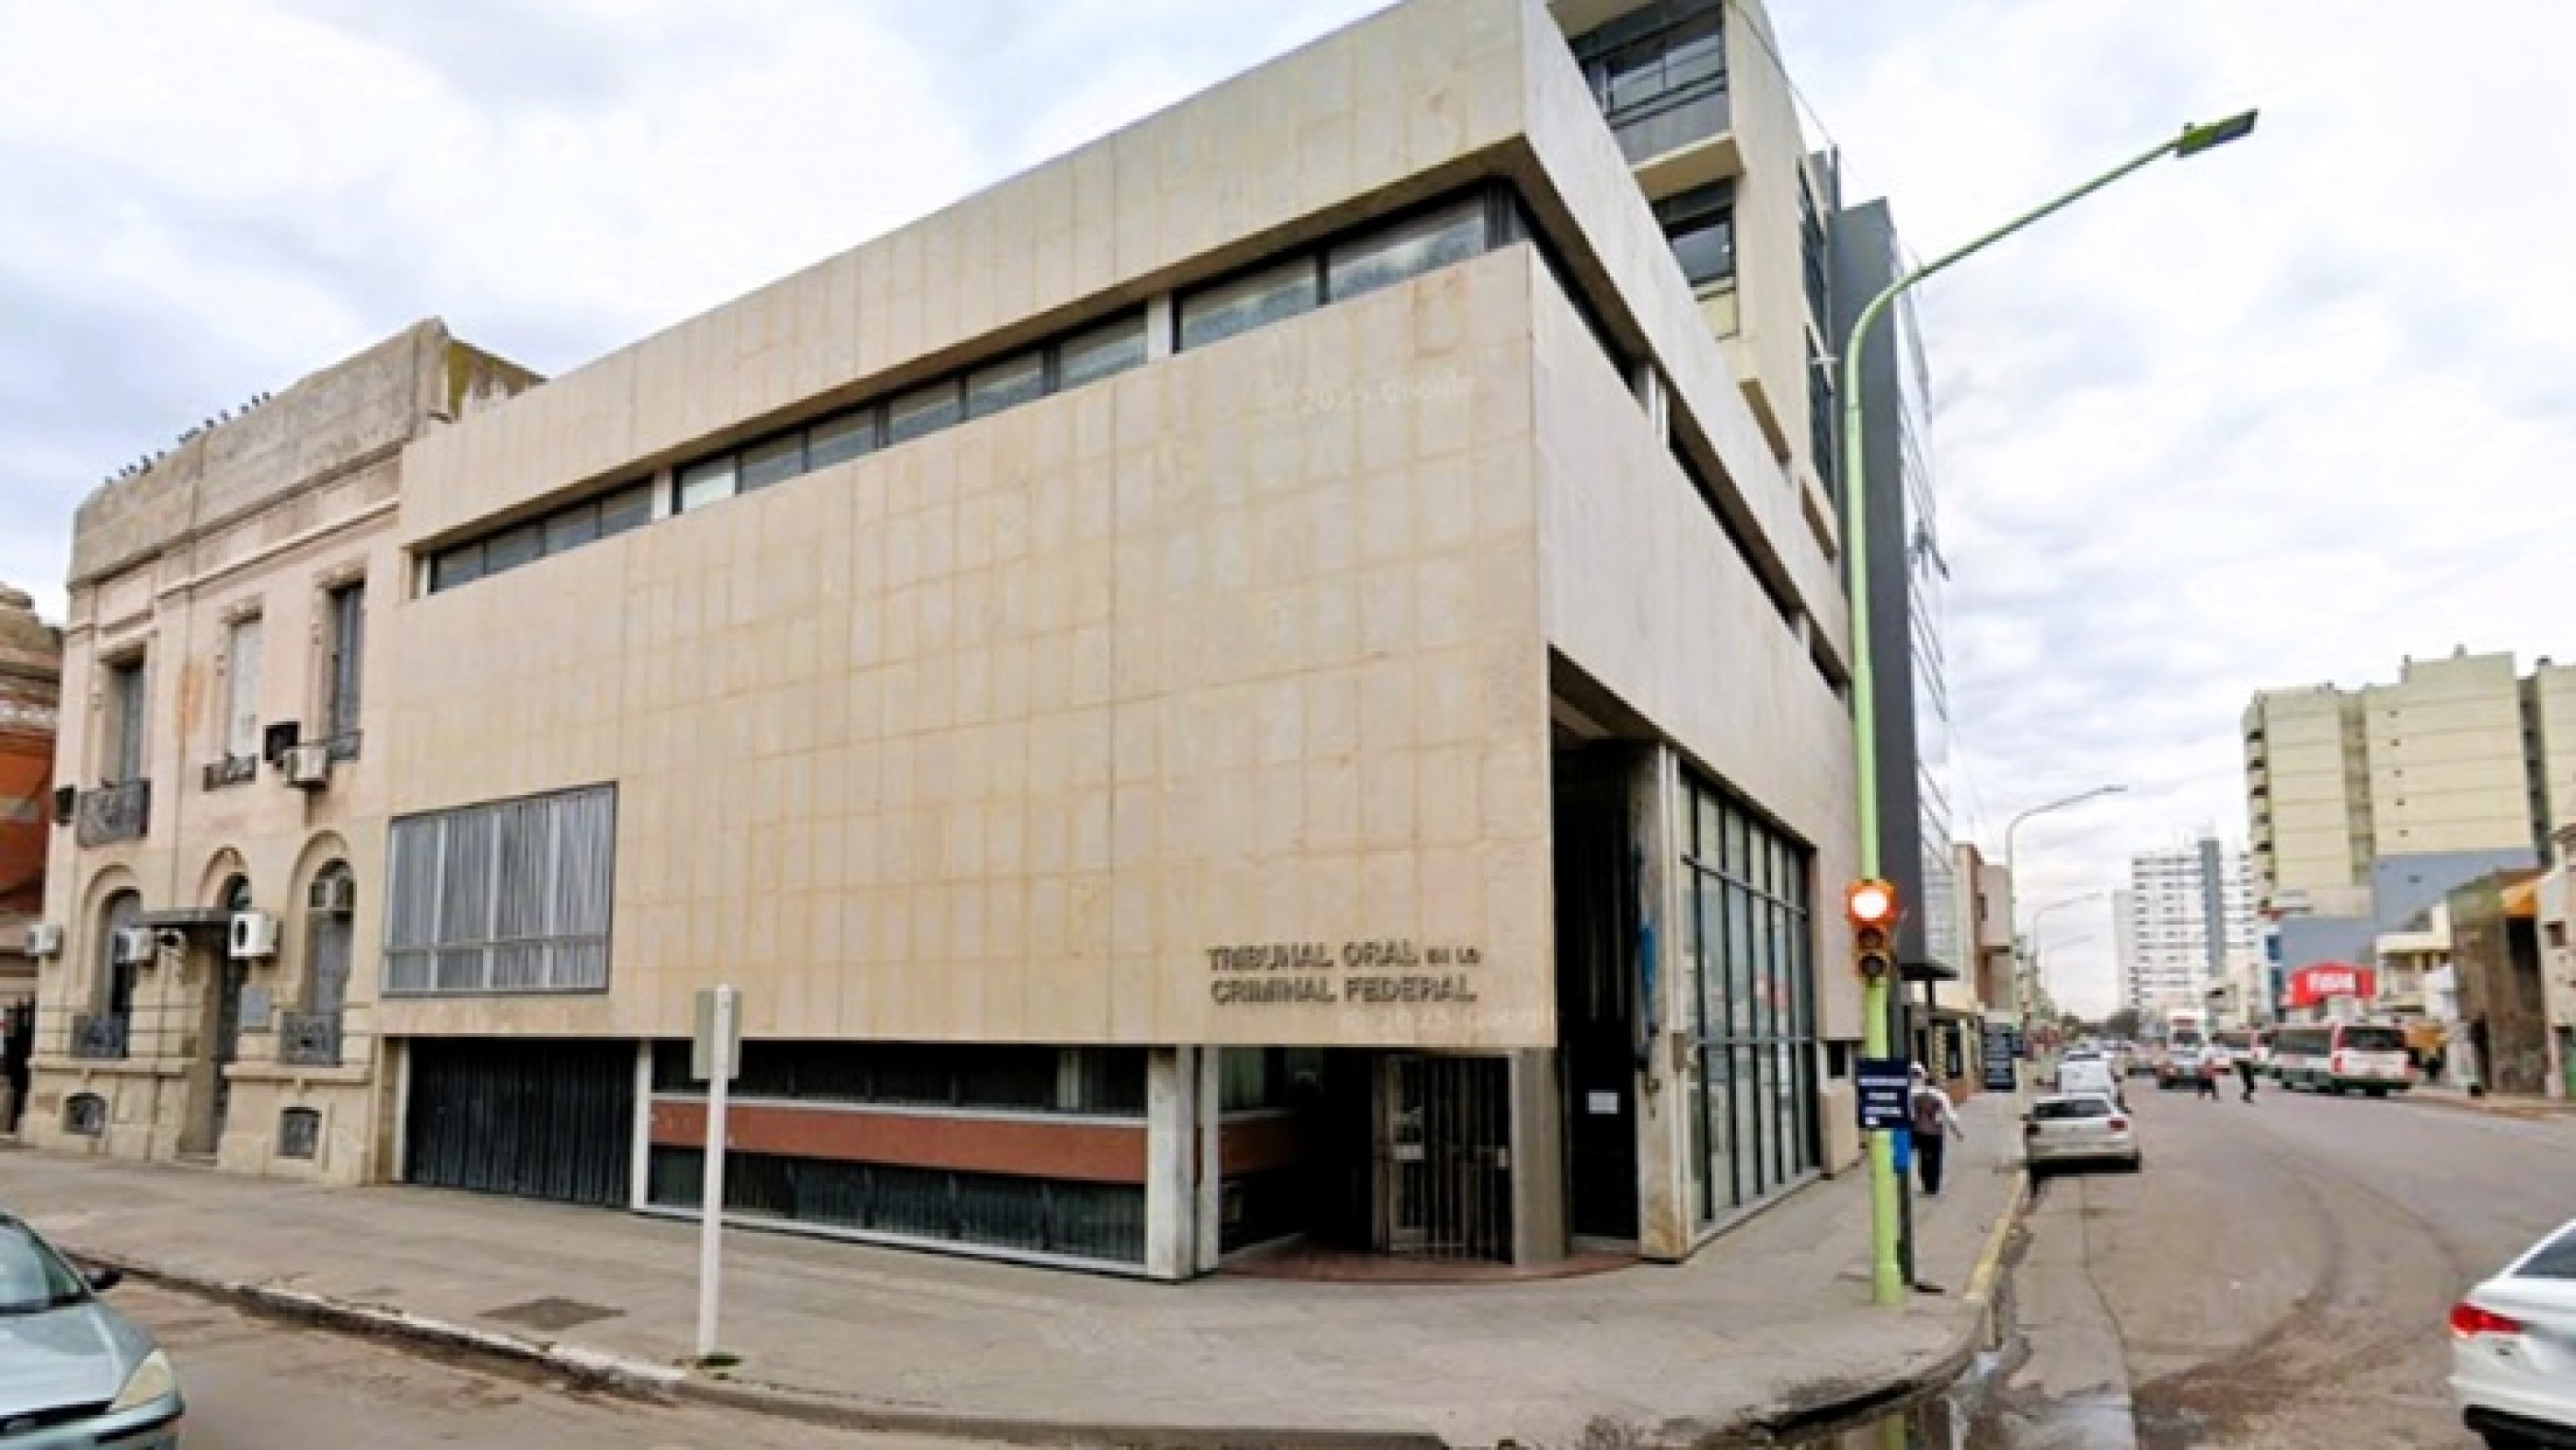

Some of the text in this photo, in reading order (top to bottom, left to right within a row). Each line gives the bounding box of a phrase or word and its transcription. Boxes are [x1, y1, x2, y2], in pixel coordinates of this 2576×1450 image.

[1204, 942, 1335, 971] TRIBUNAL
[1340, 938, 1420, 968] ORAL
[1209, 973, 1478, 1005] CRIMINAL FEDERAL
